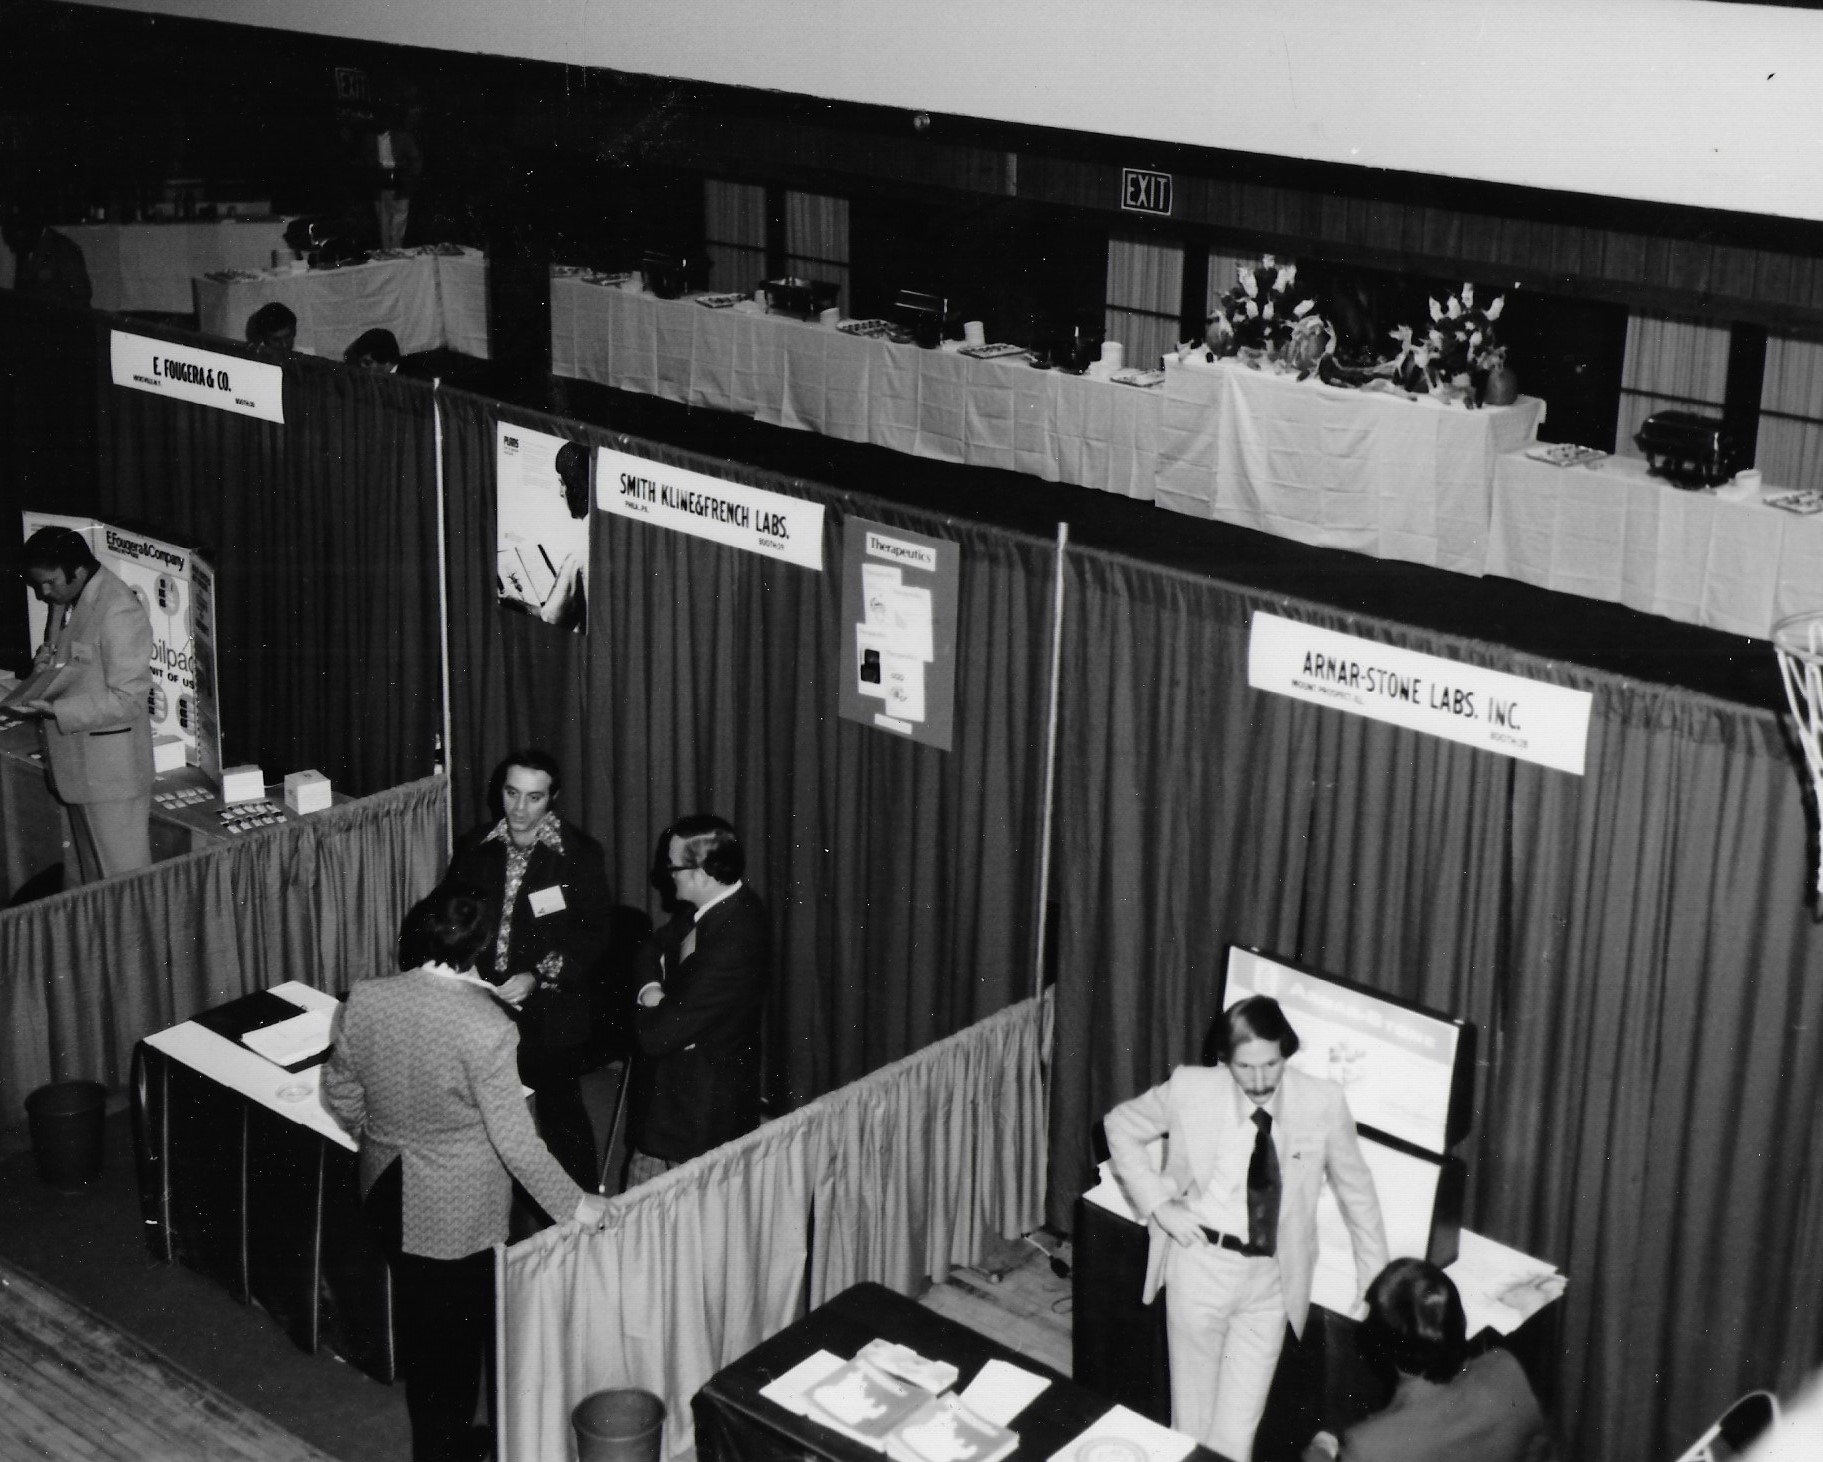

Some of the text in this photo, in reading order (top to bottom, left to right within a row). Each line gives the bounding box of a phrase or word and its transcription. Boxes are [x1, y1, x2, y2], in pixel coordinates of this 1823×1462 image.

[340, 71, 368, 99] EXIT
[1126, 173, 1168, 209] EXIT
[153, 356, 162, 376] E.
[164, 358, 206, 387] FOUGERA
[217, 370, 232, 392] CO.
[620, 473, 656, 503] SMITH
[756, 509, 790, 540] LABS.
[869, 536, 932, 564] Therapeutics
[167, 672, 179, 683] OF
[1303, 650, 1521, 731] ARNAR-STONE LABS. INC.
